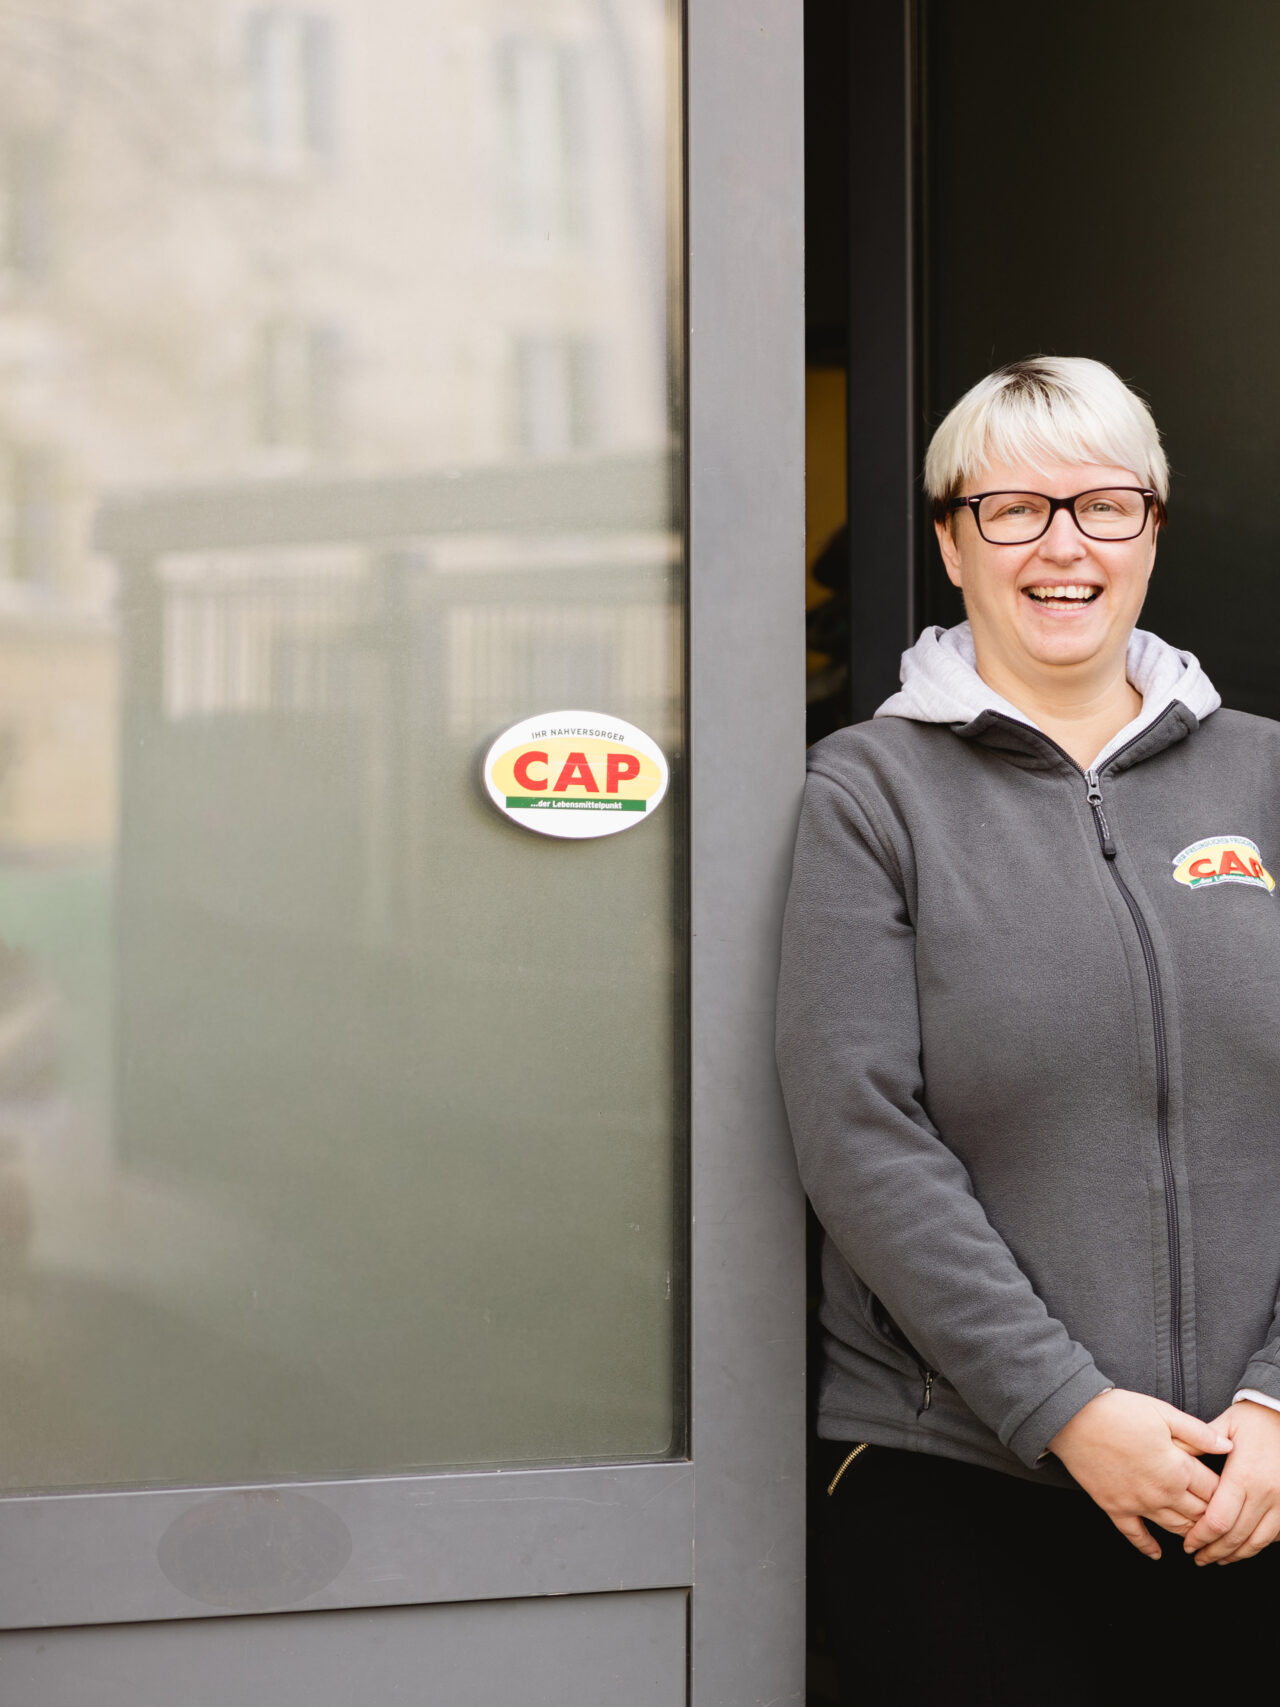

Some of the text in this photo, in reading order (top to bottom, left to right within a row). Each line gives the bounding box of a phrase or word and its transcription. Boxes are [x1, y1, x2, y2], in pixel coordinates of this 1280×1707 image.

[531, 728, 625, 742] IHR NAHVERSORGER
[513, 751, 641, 793] CAP
[552, 800, 622, 810] Lebensmittelpunkt
[1188, 850, 1264, 879] CAP
